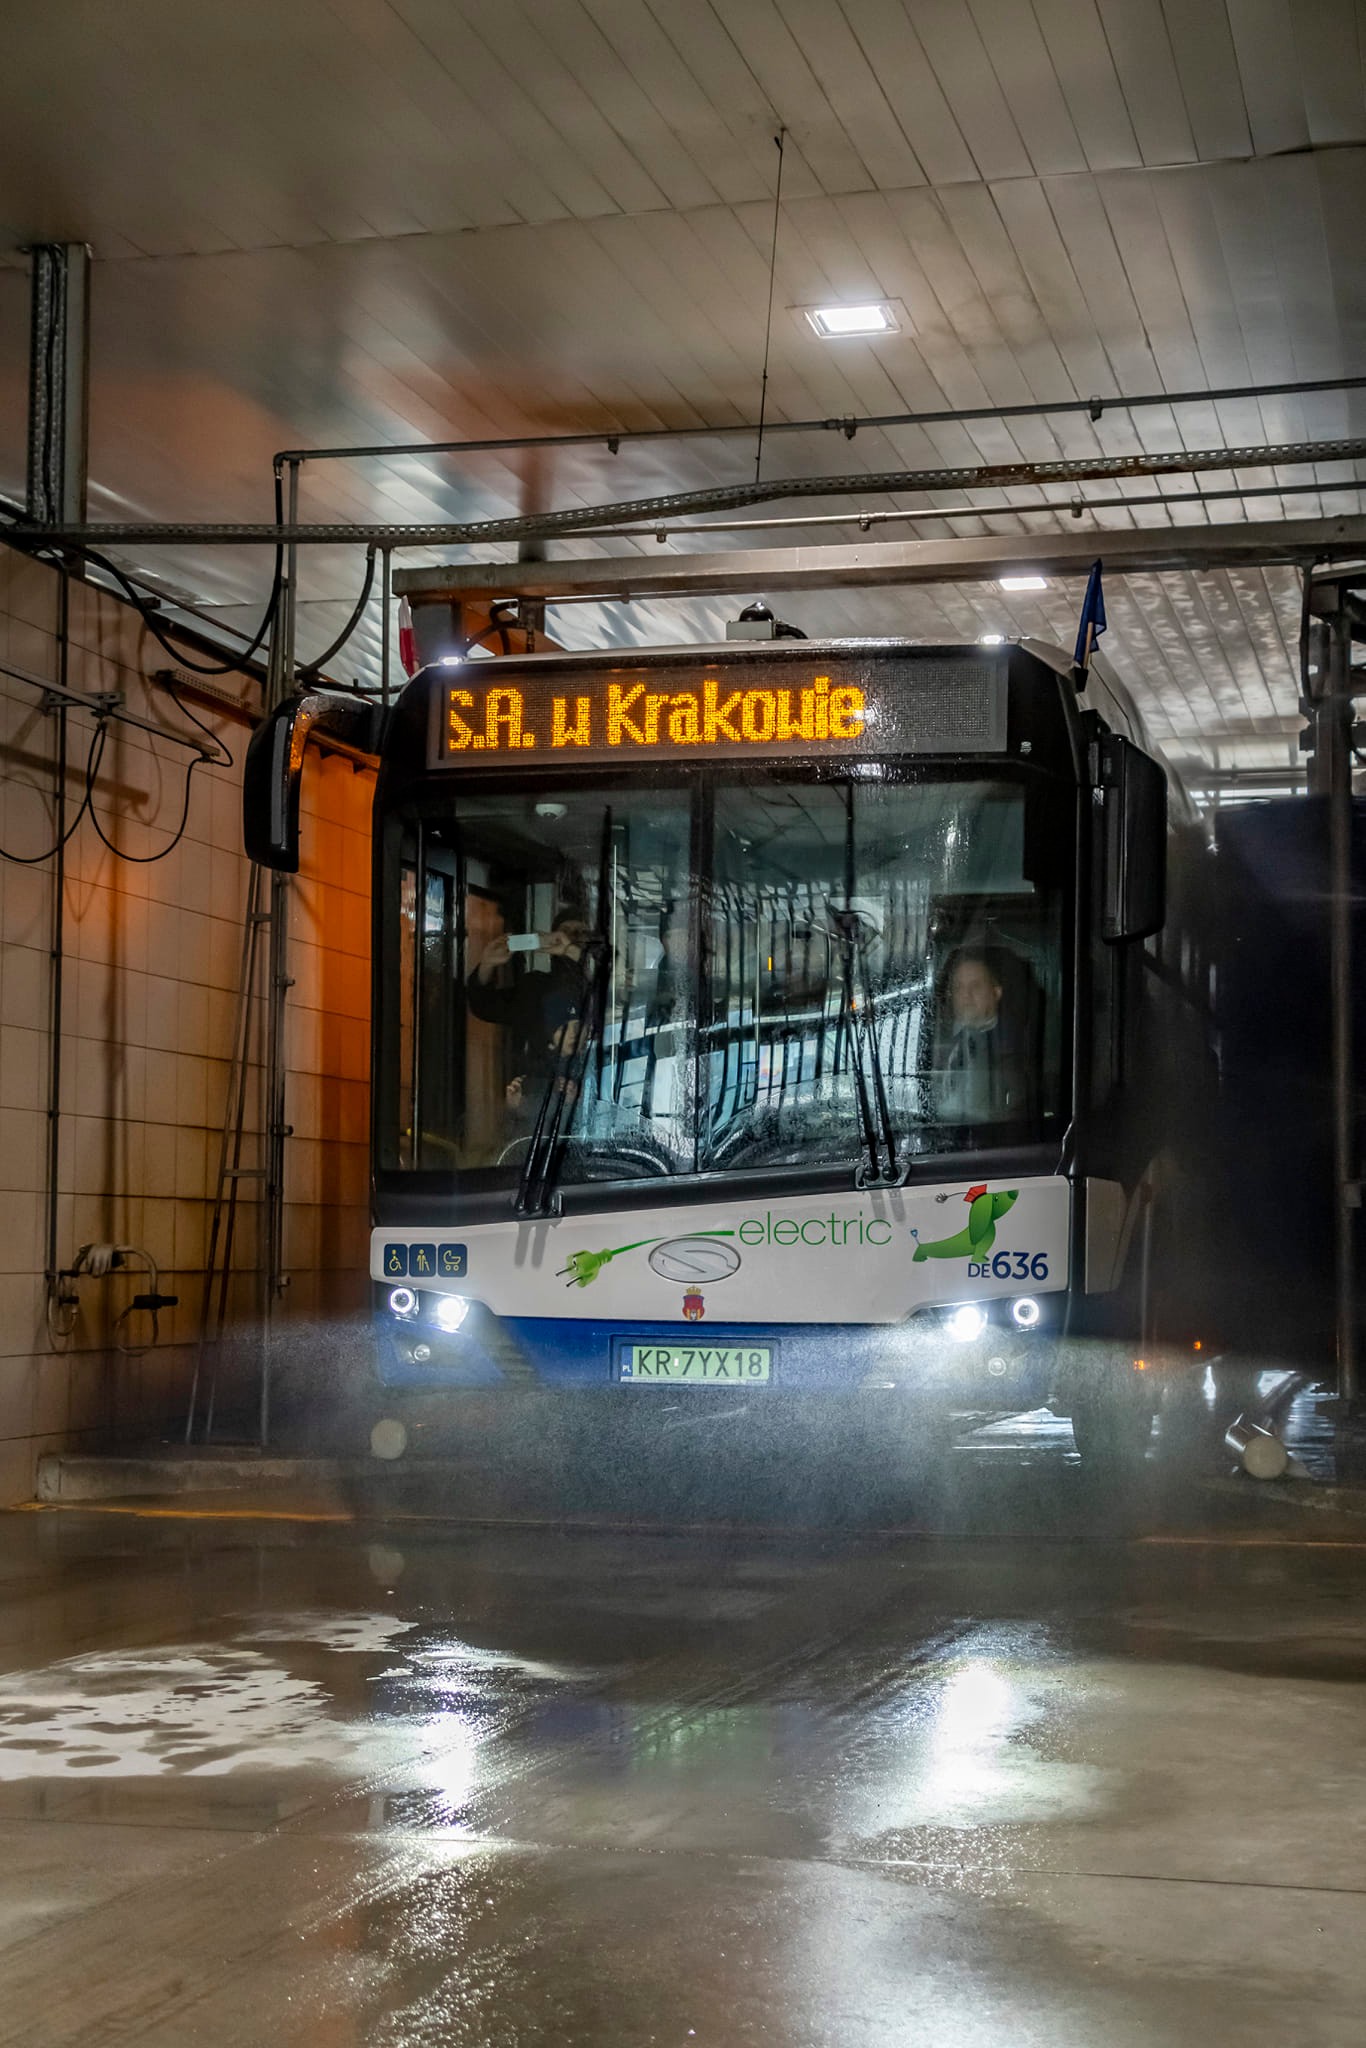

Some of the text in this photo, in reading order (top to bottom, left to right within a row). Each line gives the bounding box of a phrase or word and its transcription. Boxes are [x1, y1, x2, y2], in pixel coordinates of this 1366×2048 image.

[447, 675, 866, 751] S.A. w Krakowie
[738, 1210, 893, 1246] electric
[637, 1349, 763, 1378] KR 7YX18
